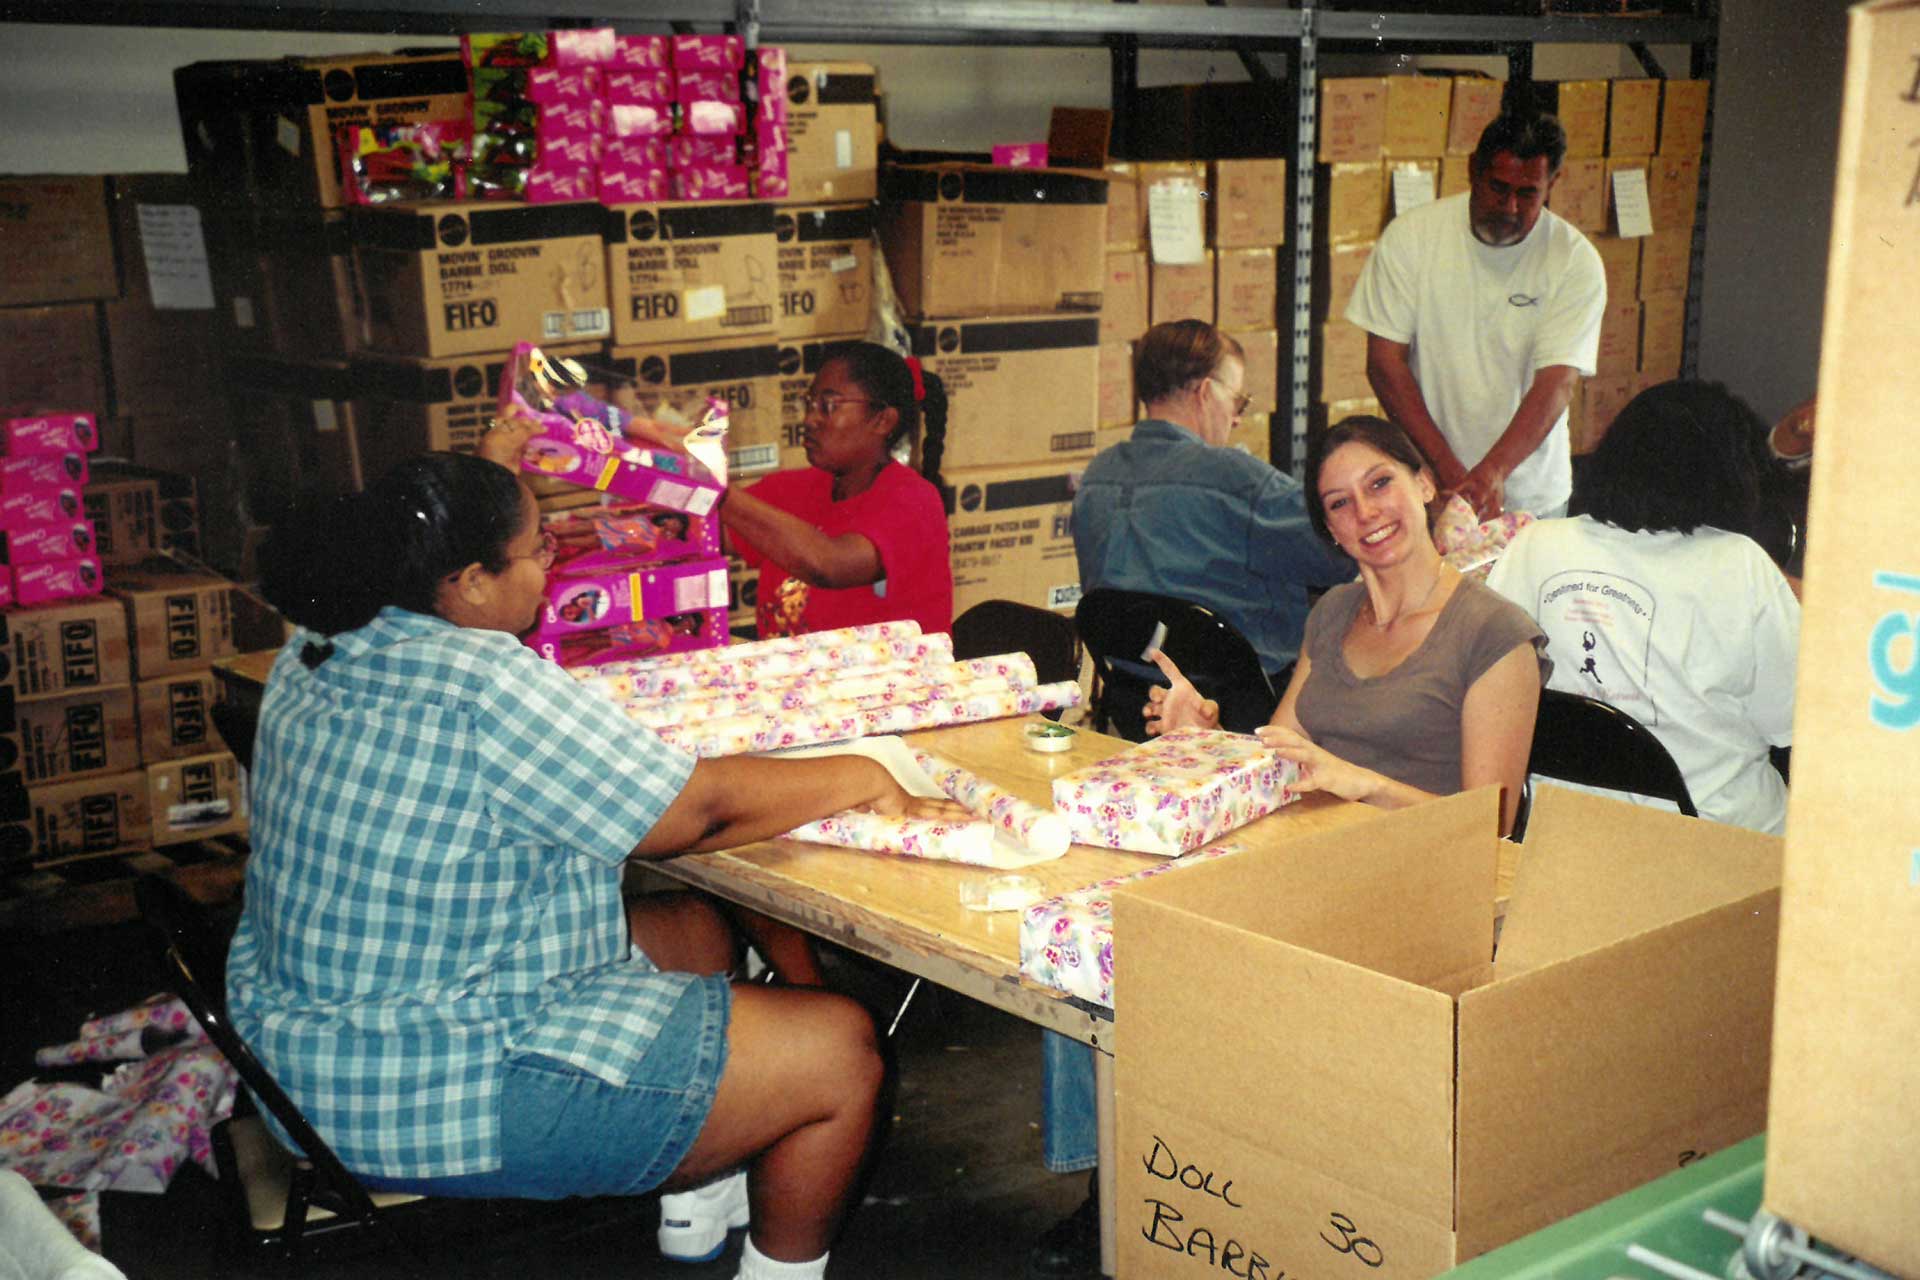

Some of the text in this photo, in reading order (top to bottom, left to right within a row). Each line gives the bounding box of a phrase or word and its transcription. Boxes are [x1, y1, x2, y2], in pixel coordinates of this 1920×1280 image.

[446, 300, 497, 331] FIFO
[632, 291, 679, 321] FIFO
[1587, 584, 1600, 593] for
[65, 622, 97, 685] FIFO
[170, 596, 198, 658] FIFO
[71, 707, 103, 770] FIFO
[173, 685, 205, 742] FIFO
[184, 766, 212, 803] FIF
[1142, 1135, 1242, 1207] DOLL
[1142, 1199, 1297, 1280] BARB
[1319, 1212, 1384, 1268] 30
